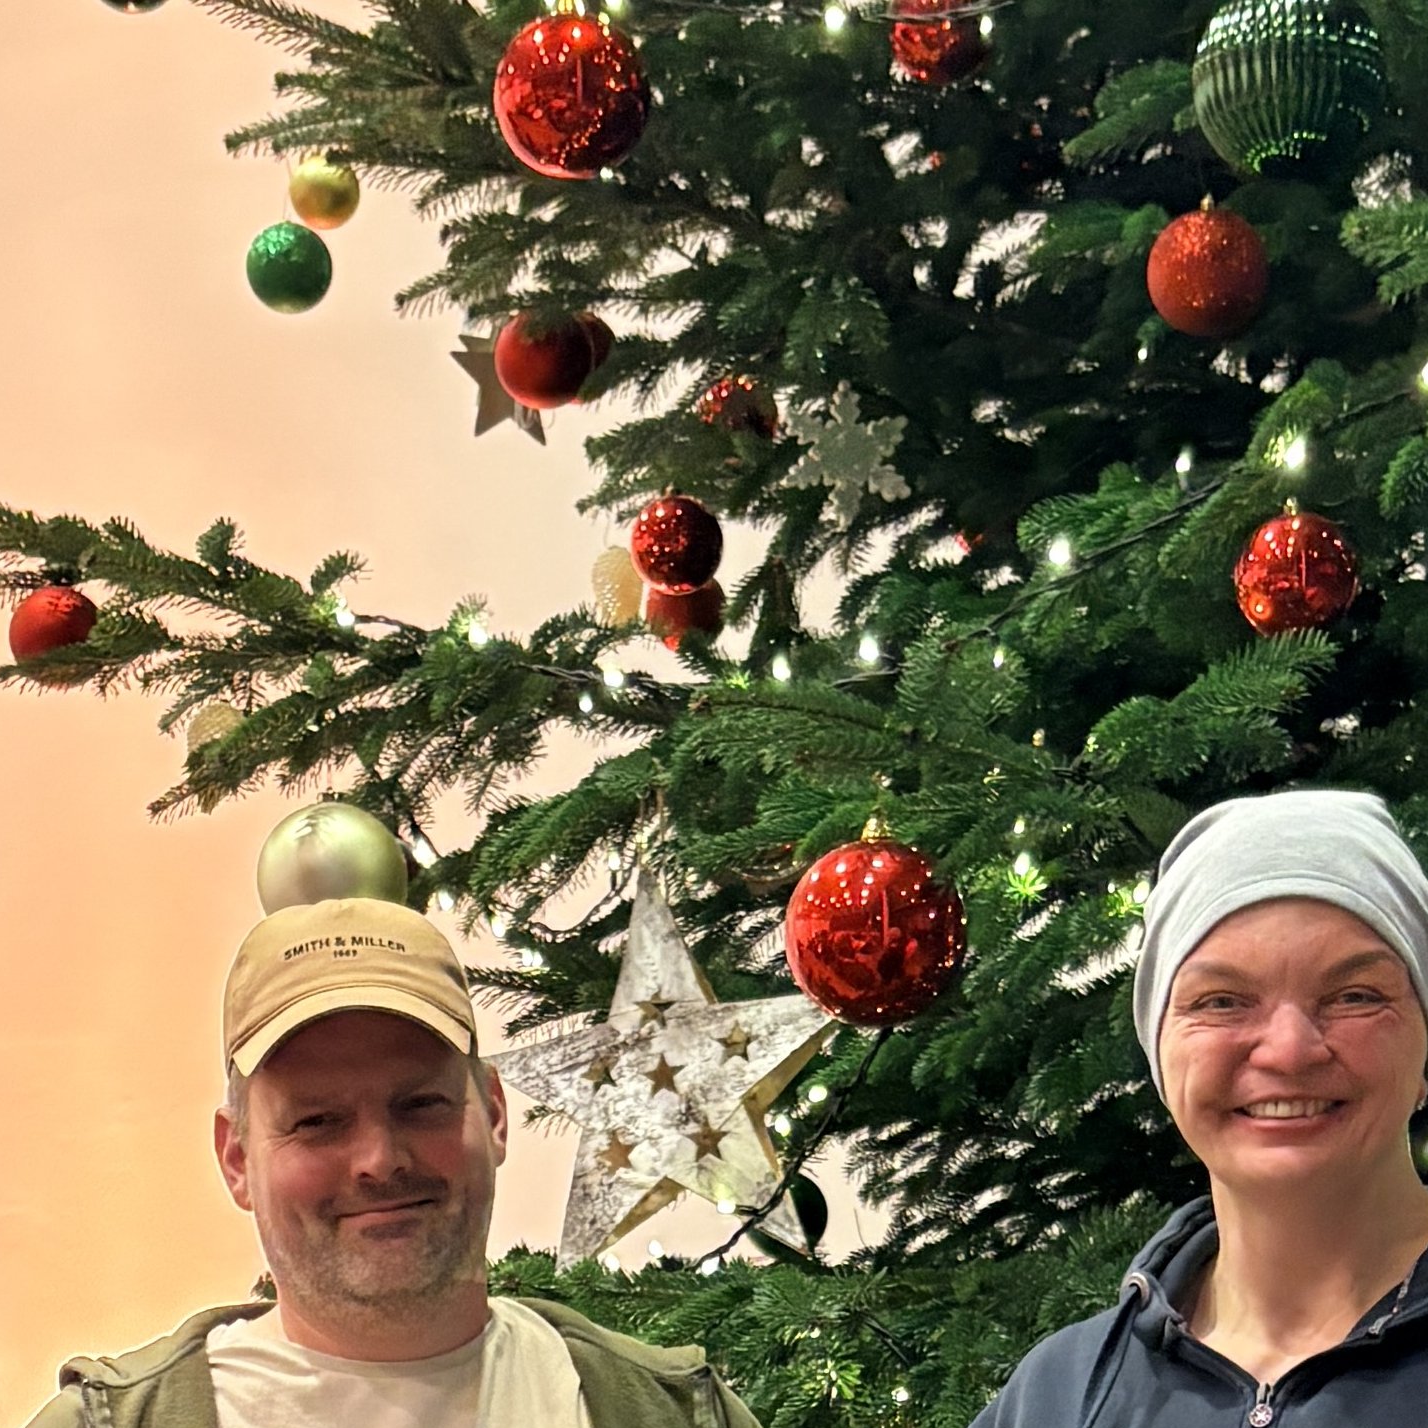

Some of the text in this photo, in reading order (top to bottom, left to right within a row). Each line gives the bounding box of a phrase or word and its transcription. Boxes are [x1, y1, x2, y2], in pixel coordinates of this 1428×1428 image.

[284, 936, 406, 961] SMITH & MILLER
